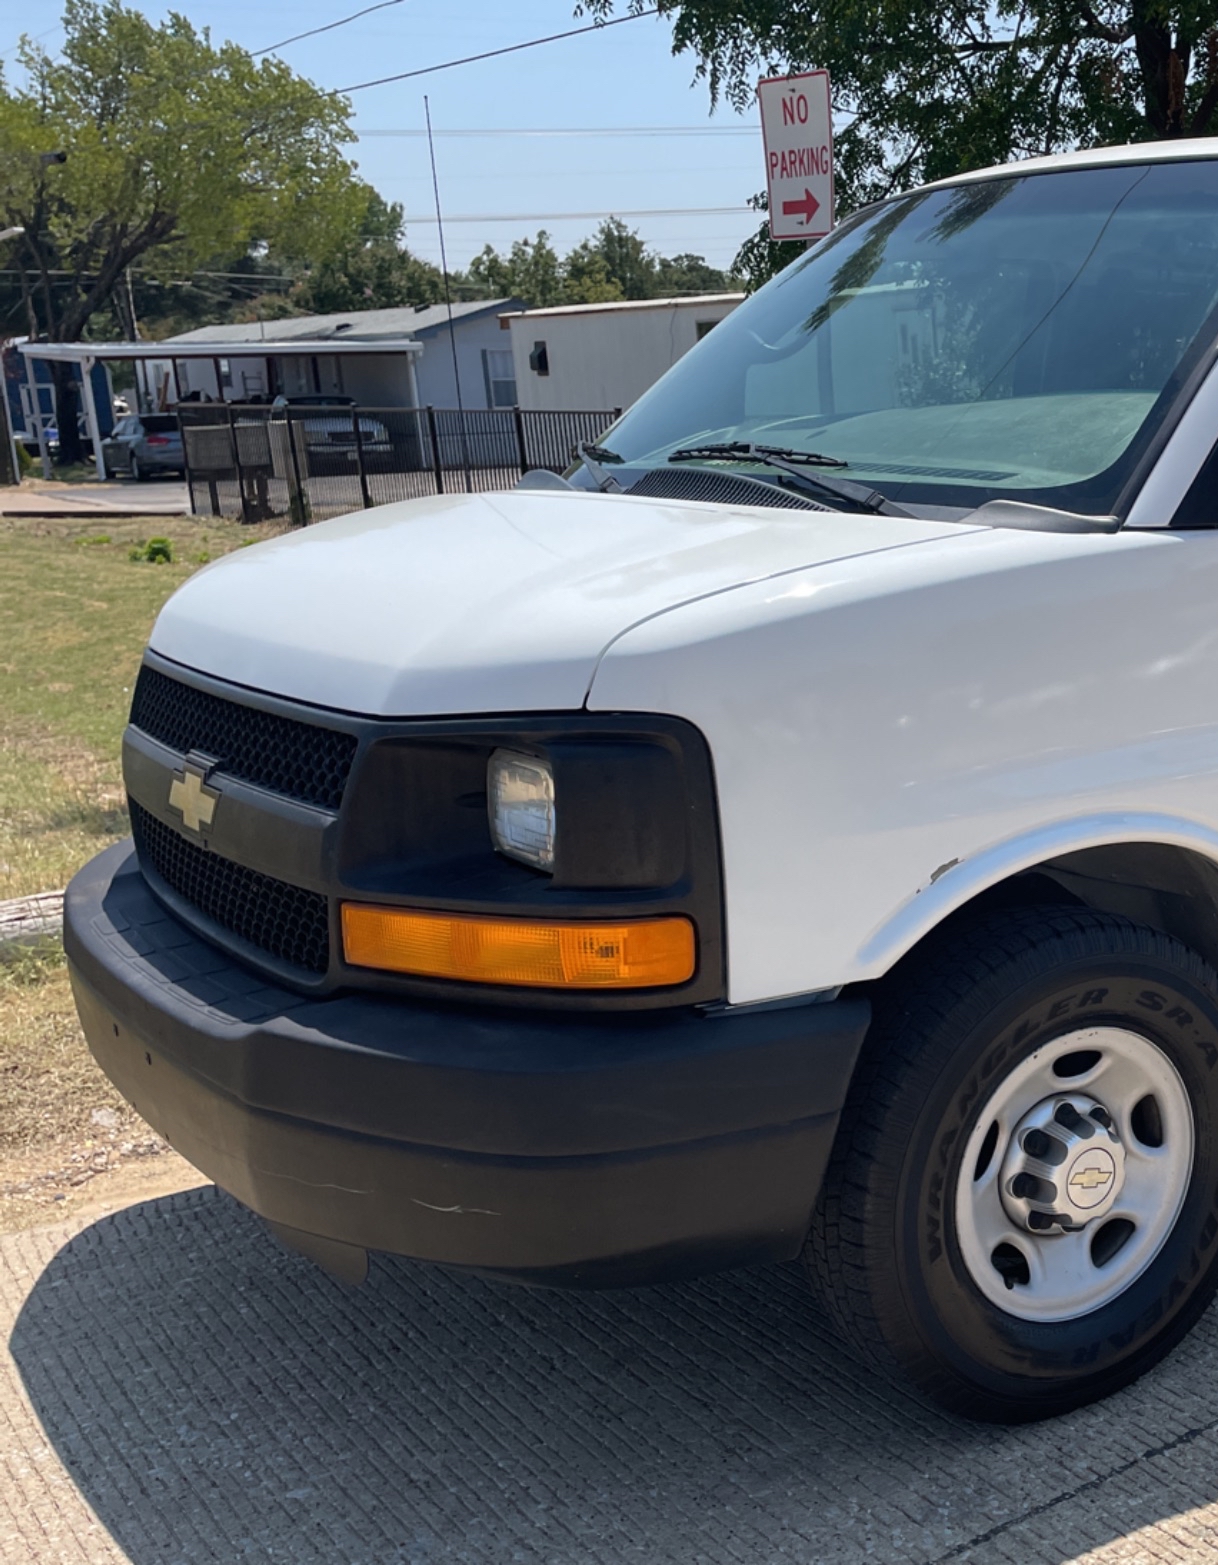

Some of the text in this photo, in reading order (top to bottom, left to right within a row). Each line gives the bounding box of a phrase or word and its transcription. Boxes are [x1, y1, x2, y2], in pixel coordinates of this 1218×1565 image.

[782, 95, 808, 126] NO
[769, 145, 829, 180] PARKING
[925, 987, 1109, 1265] WRANGLER
